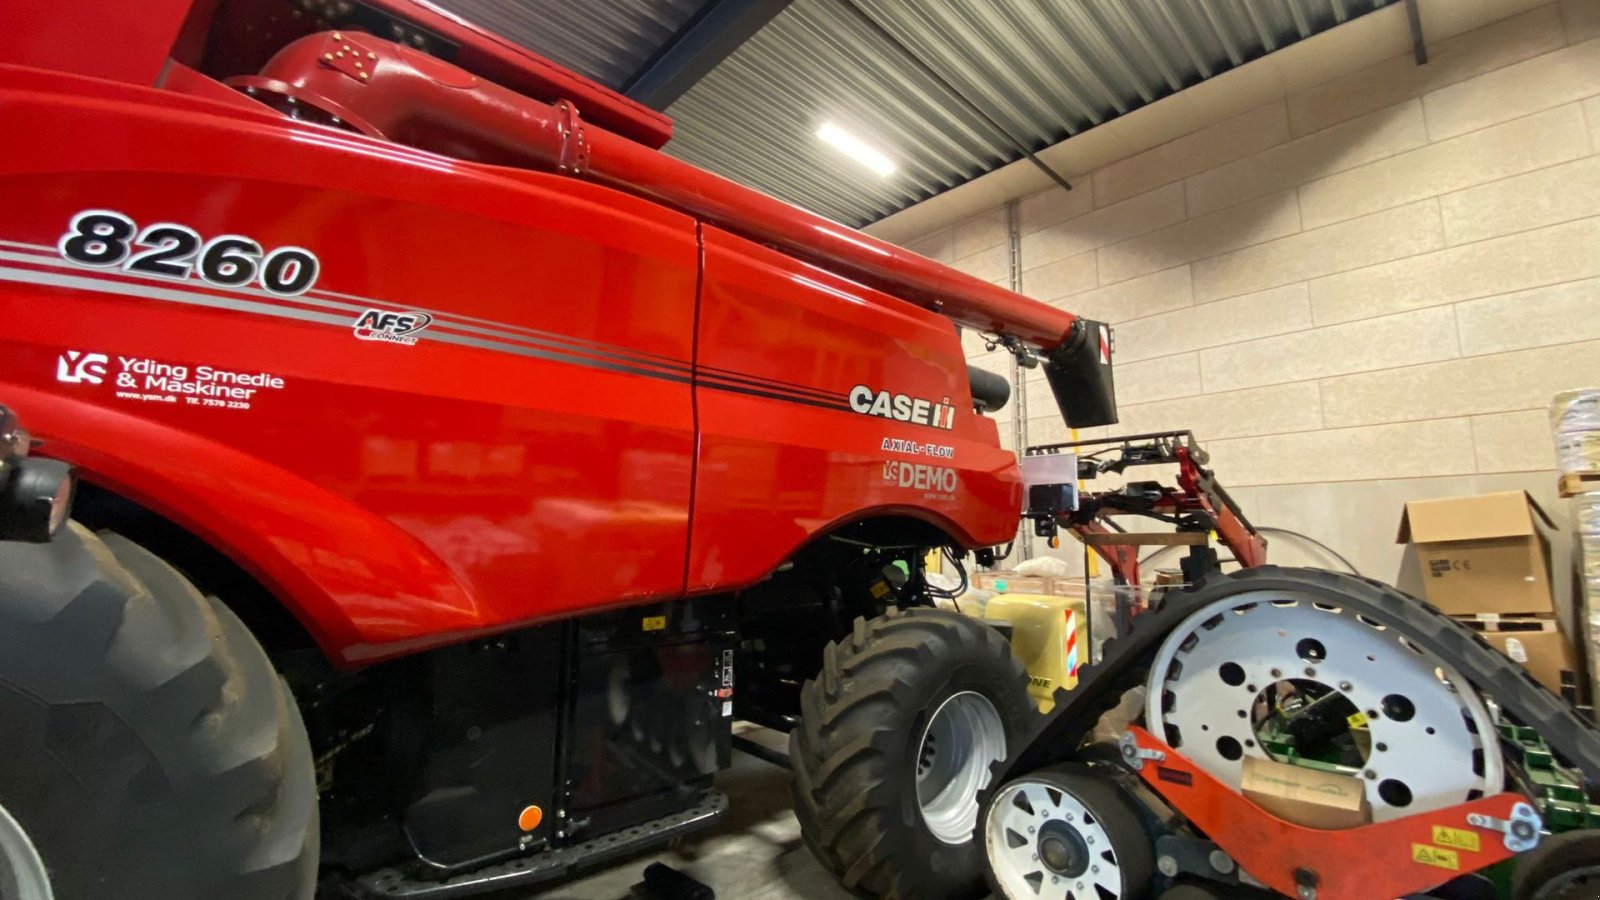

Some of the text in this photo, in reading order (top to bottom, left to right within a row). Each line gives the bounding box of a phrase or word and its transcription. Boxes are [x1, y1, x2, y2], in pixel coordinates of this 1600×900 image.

[59, 210, 320, 296] 8260
[355, 308, 415, 333] AFS
[370, 330, 417, 345] CONNECT
[116, 372, 257, 400] & Maskiner
[118, 356, 284, 389] Yding Smedie
[116, 391, 177, 402] www.ysm.dk
[849, 385, 930, 425] CASE
[881, 438, 954, 458] AXIAL-FLOW
[899, 462, 957, 492] DEMO
